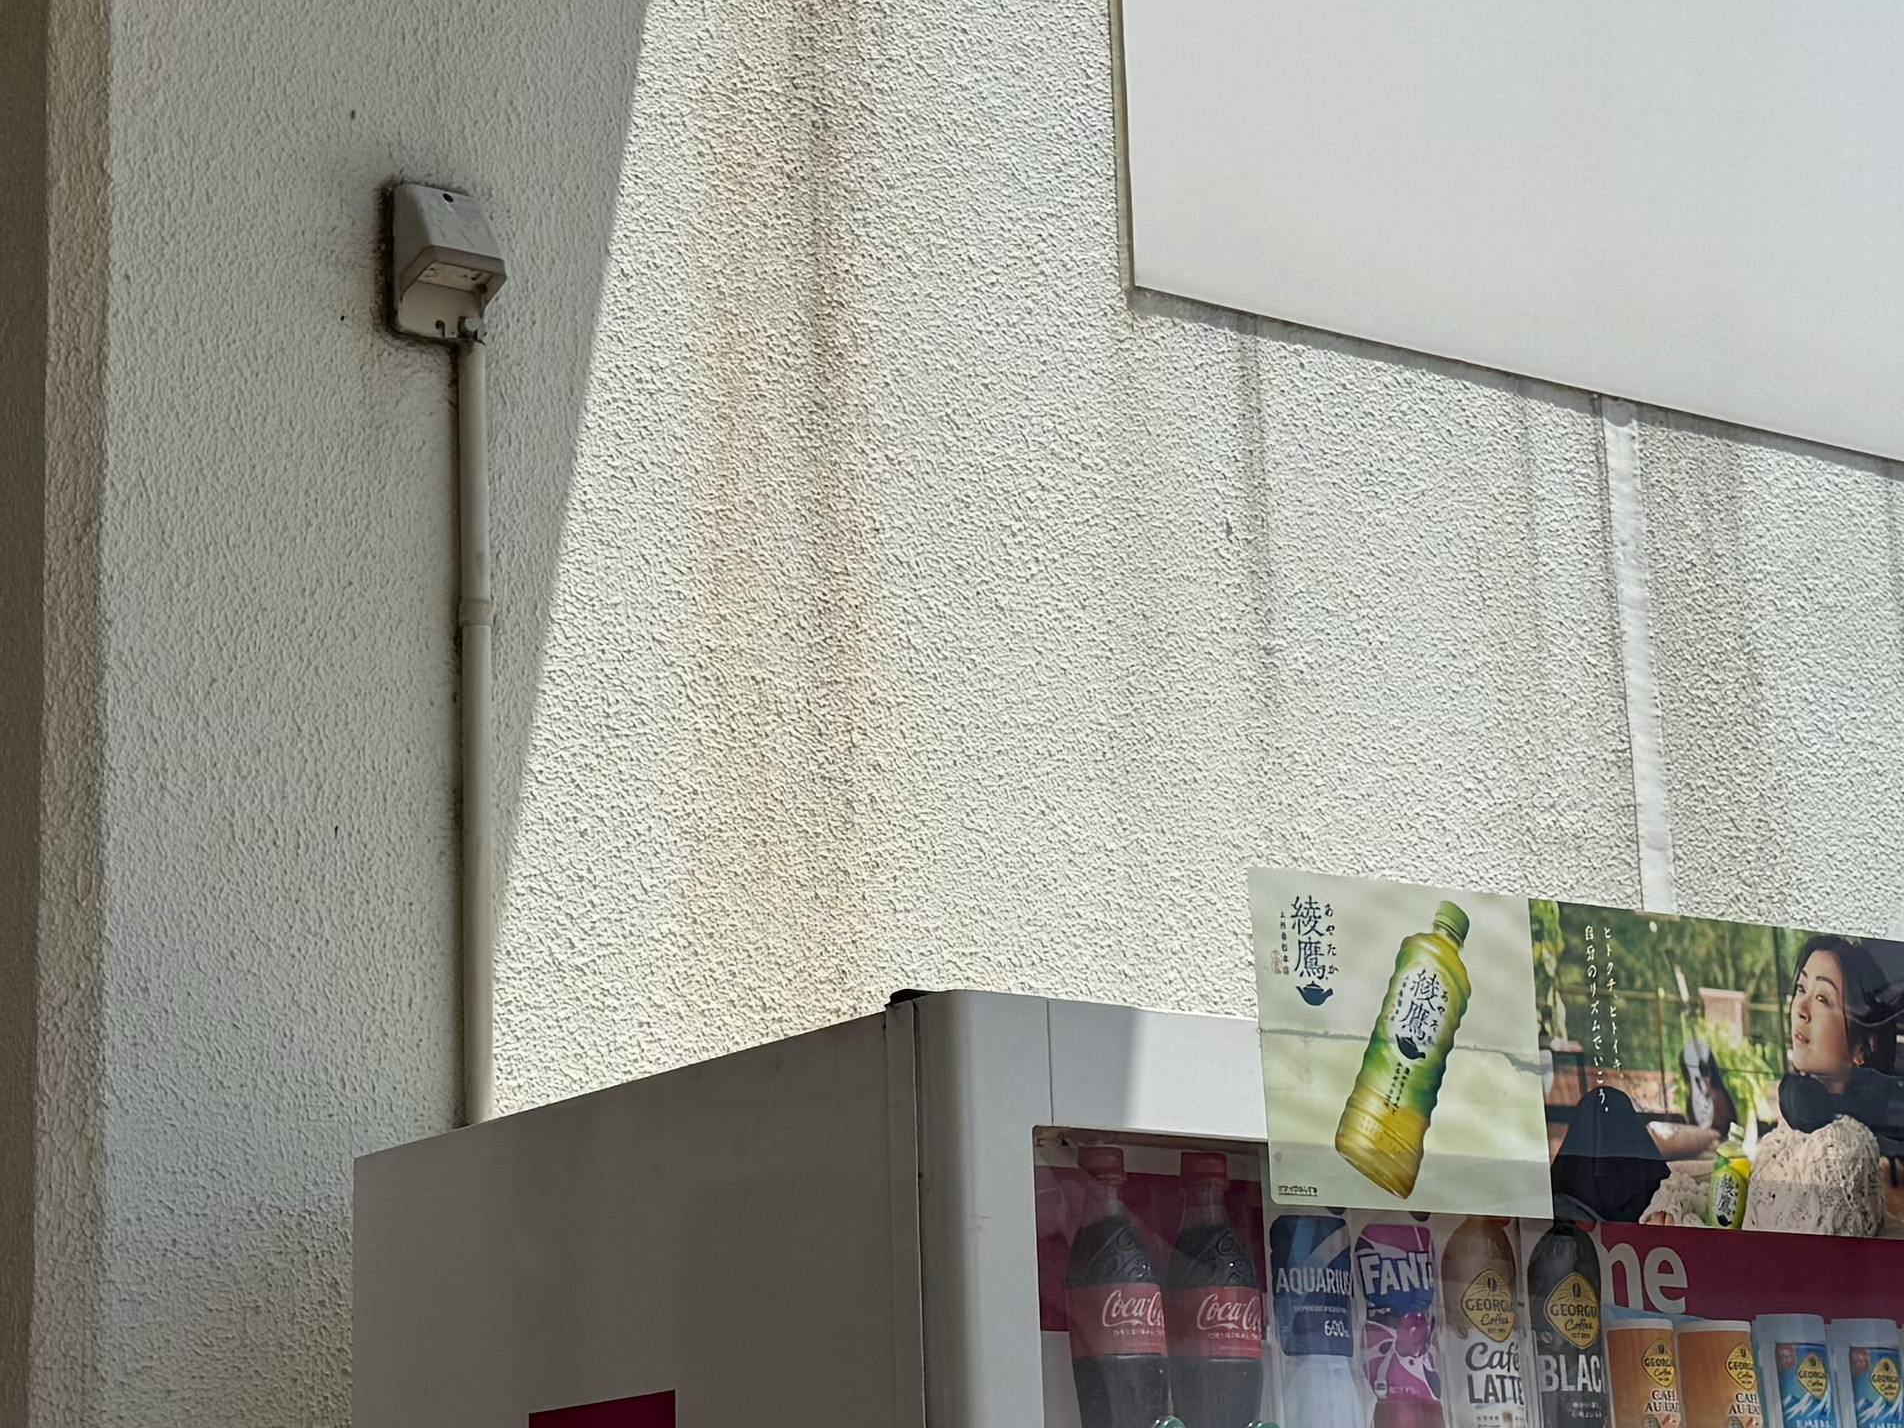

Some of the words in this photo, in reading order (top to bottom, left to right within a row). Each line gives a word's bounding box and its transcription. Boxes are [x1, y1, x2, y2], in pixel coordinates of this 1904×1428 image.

[1291, 895, 1327, 980] 綾鷹
[1360, 1252, 1434, 1295] FANT
[1465, 1341, 1521, 1372] Café
[1541, 1354, 1603, 1393] BLAC
